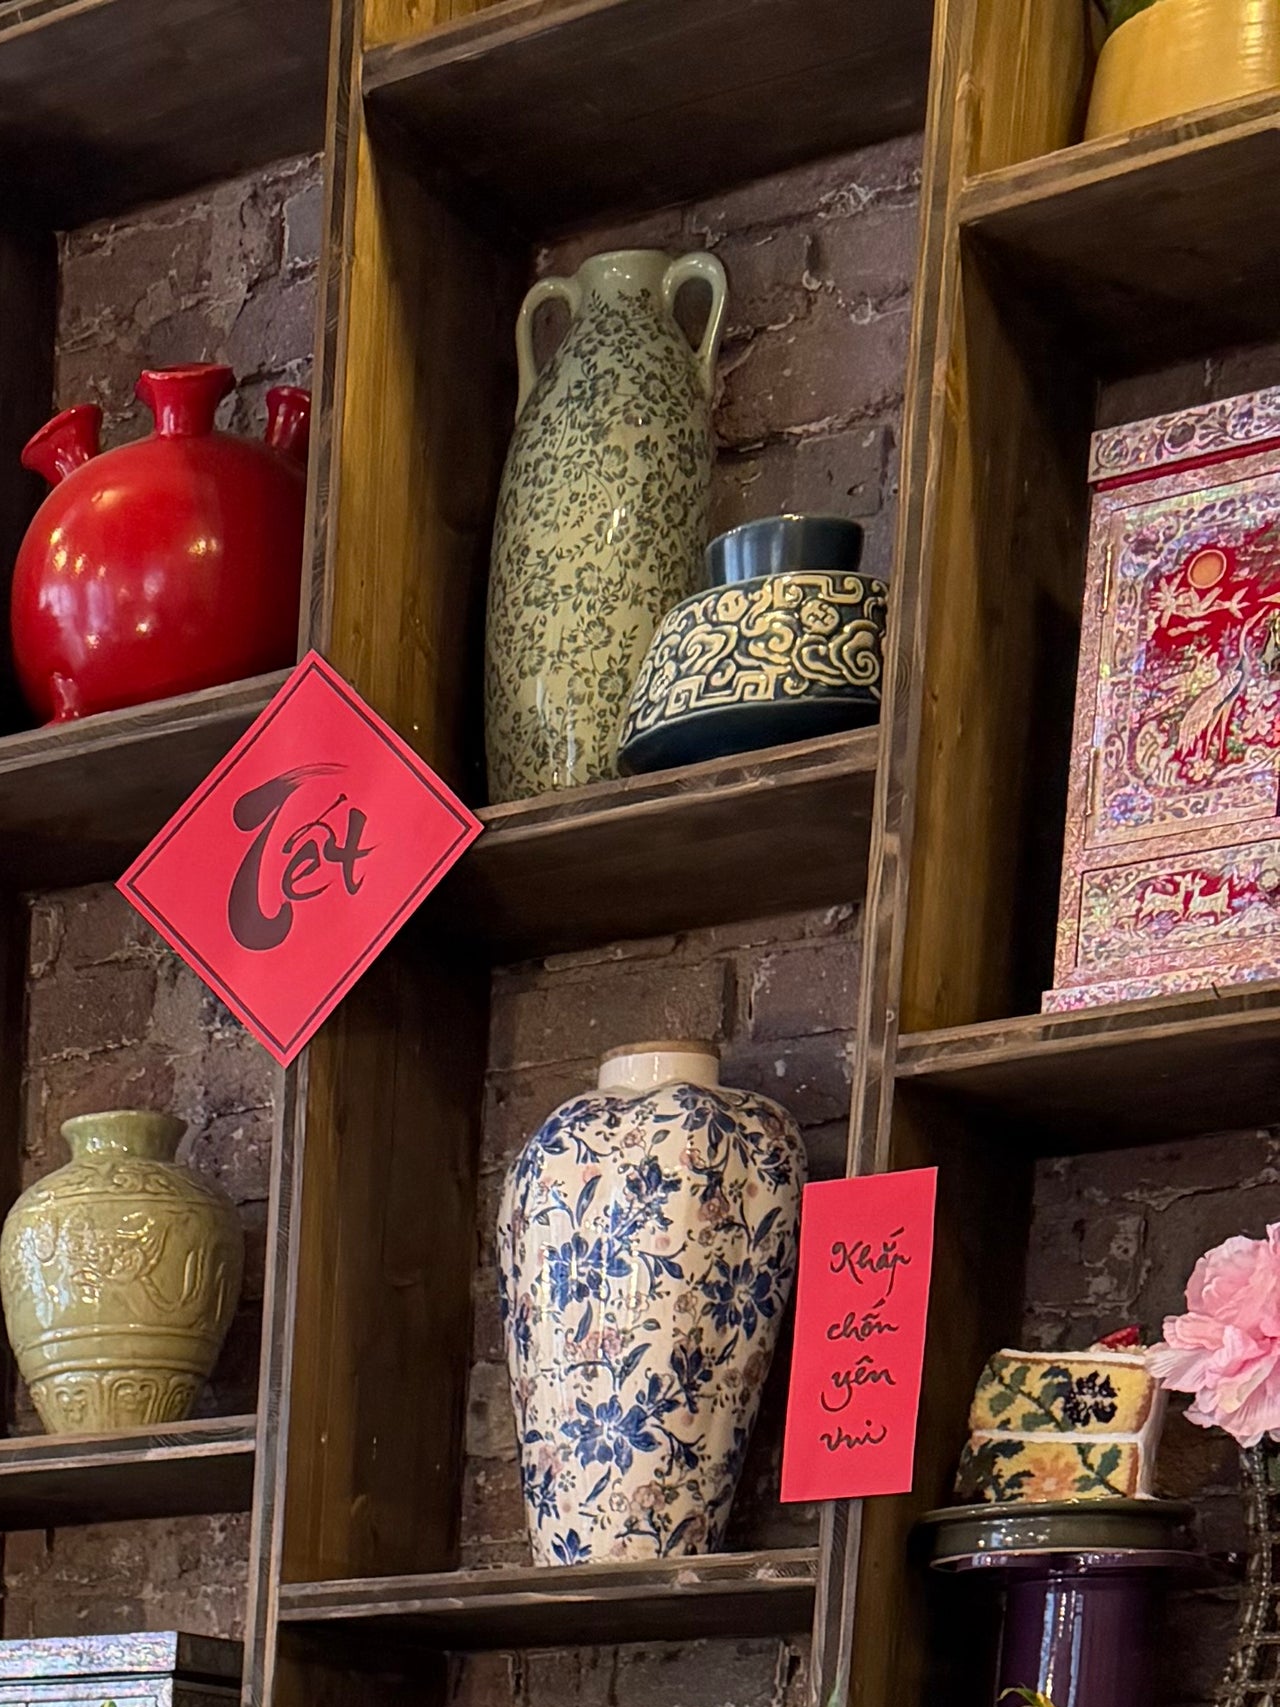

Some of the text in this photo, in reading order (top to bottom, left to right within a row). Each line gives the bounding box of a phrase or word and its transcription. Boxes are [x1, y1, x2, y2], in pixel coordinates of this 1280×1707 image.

[228, 761, 377, 951] Tết
[820, 1355, 897, 1412] yên
[820, 1419, 888, 1453] vui
